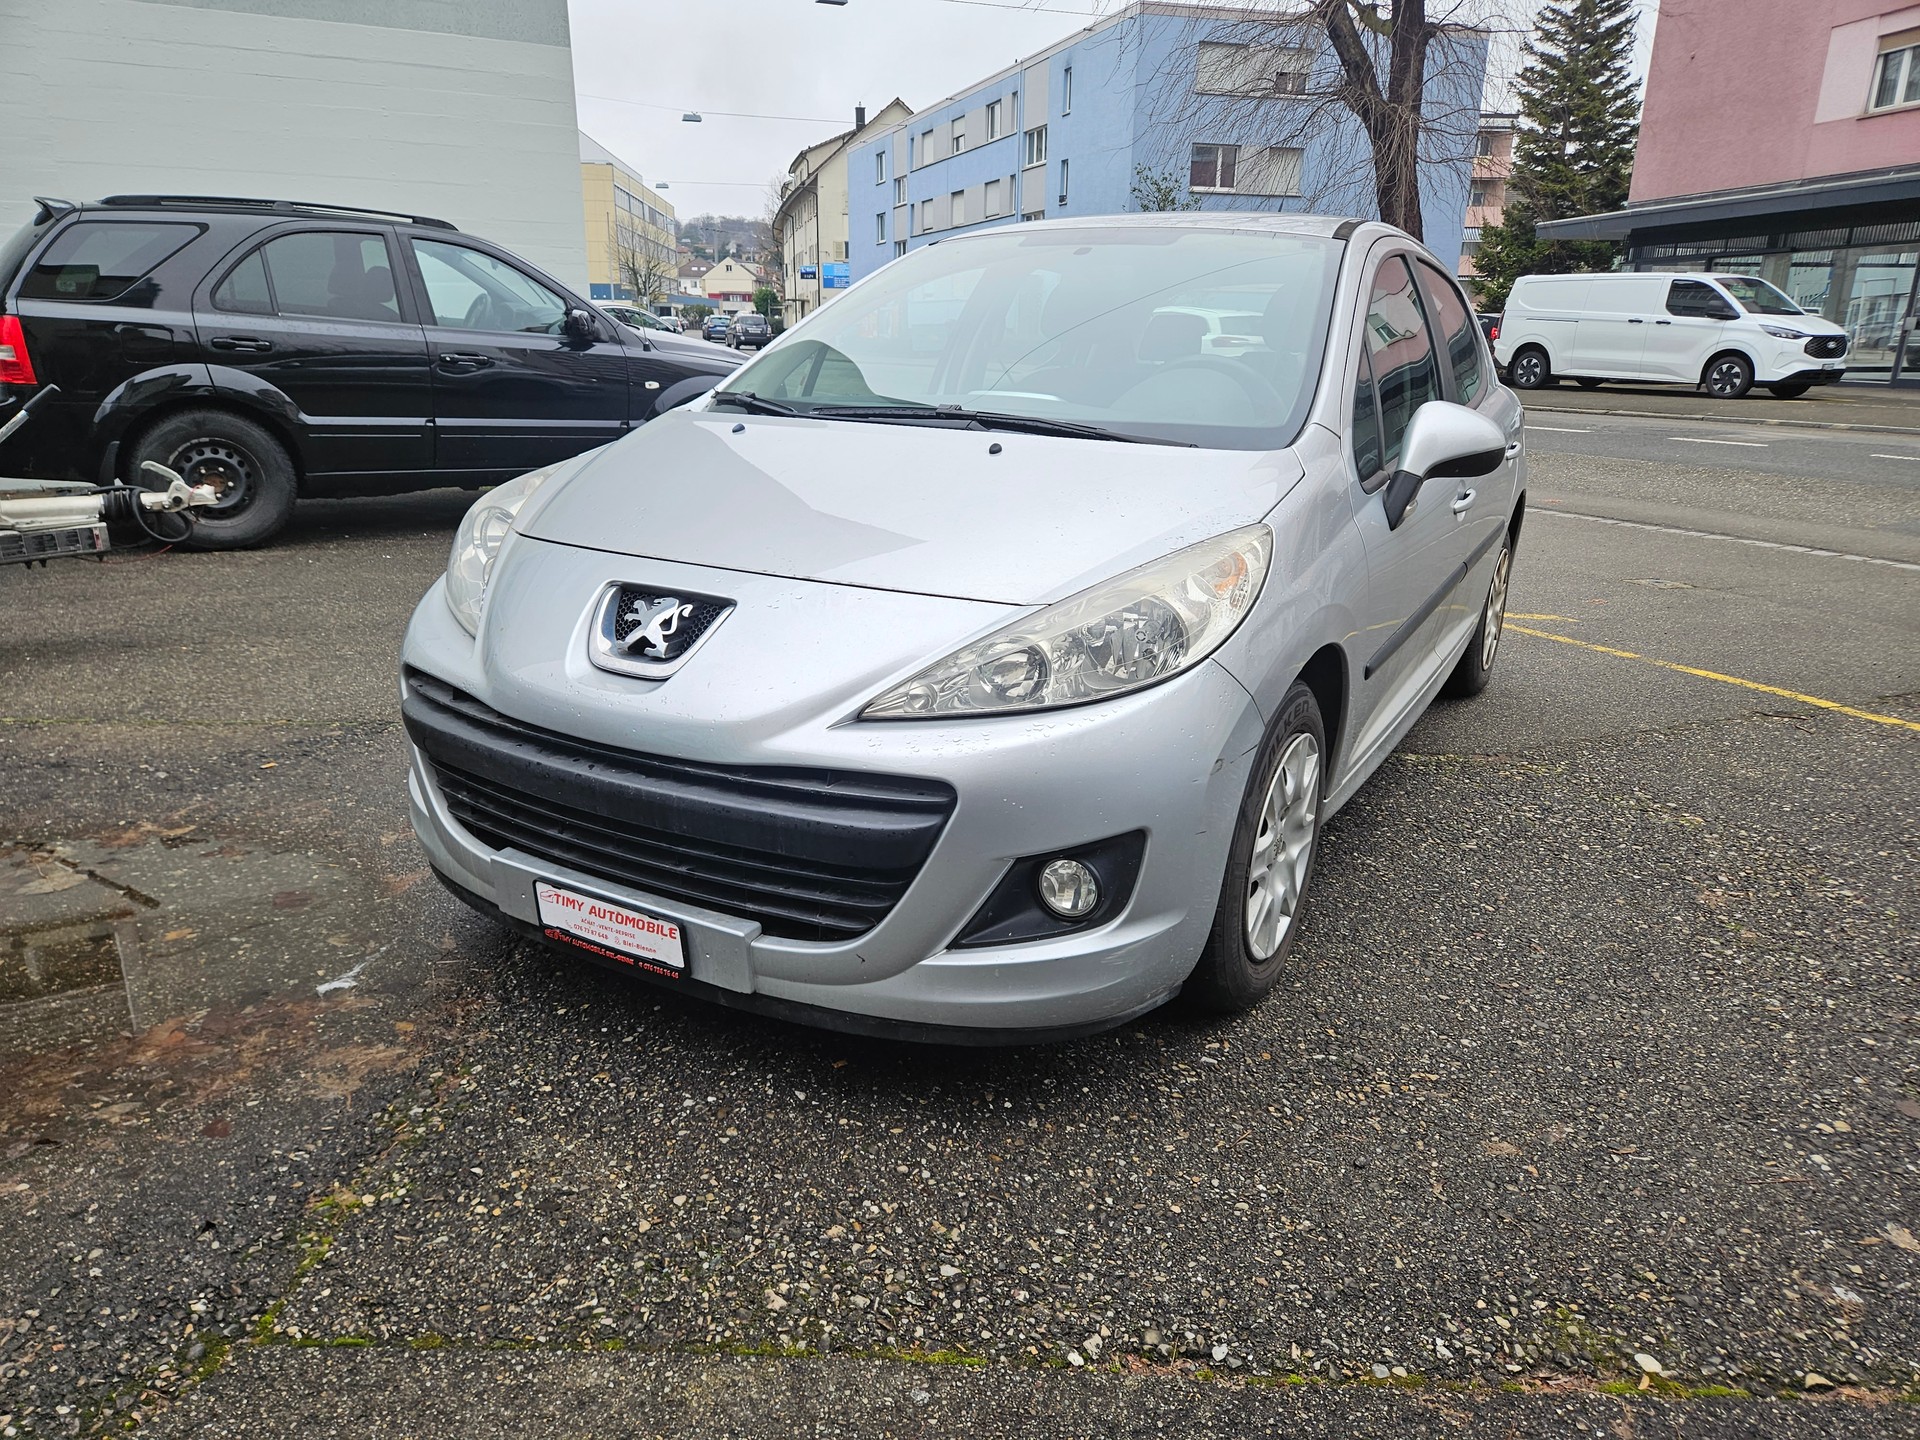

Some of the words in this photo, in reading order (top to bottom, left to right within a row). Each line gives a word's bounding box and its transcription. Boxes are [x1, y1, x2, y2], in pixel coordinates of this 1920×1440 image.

[554, 893, 585, 911] TIMY
[588, 905, 678, 940] AUTOMOBILE
[573, 923, 584, 932] 076
[571, 938, 606, 956] AUTOMOBILE
